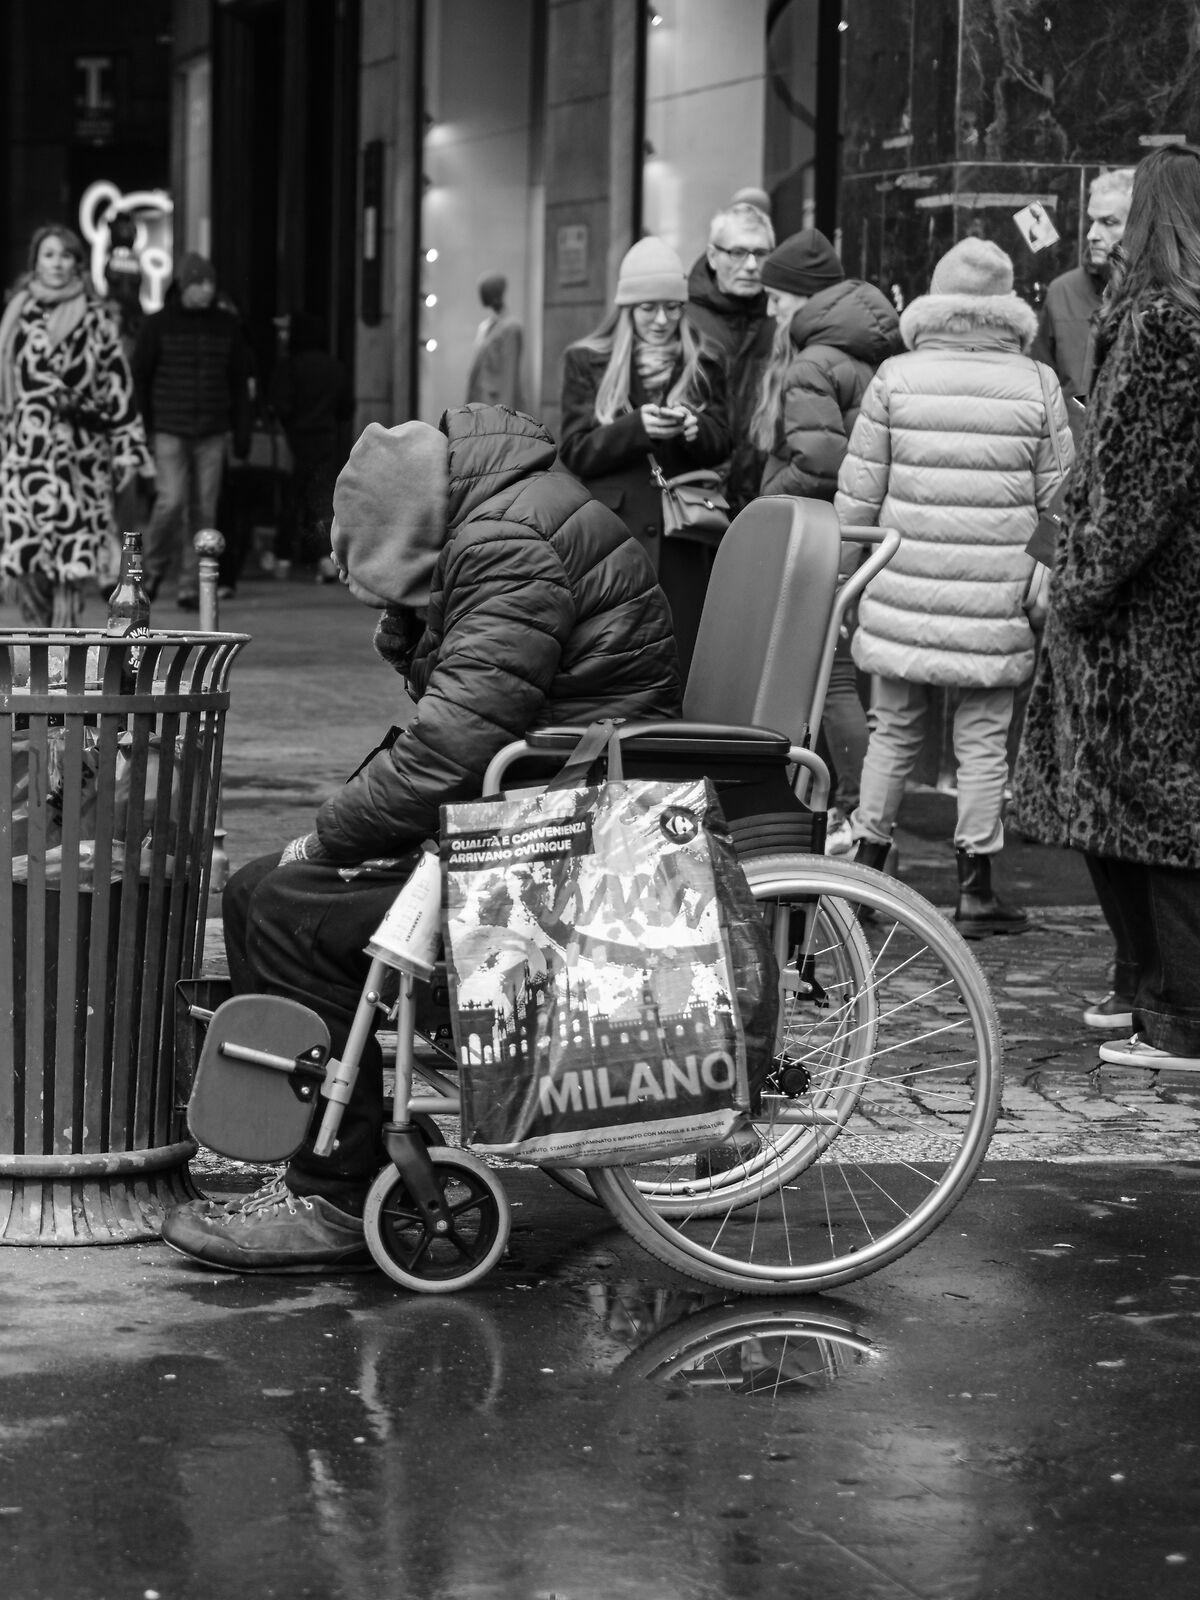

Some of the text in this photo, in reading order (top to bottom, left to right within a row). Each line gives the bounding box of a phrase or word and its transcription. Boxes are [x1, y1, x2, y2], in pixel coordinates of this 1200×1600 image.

[449, 839, 572, 863] ARRIVANO OVUNQUE
[451, 822, 586, 851] QUALITÀ E CONVENIENZA
[538, 1050, 736, 1116] MILANO
